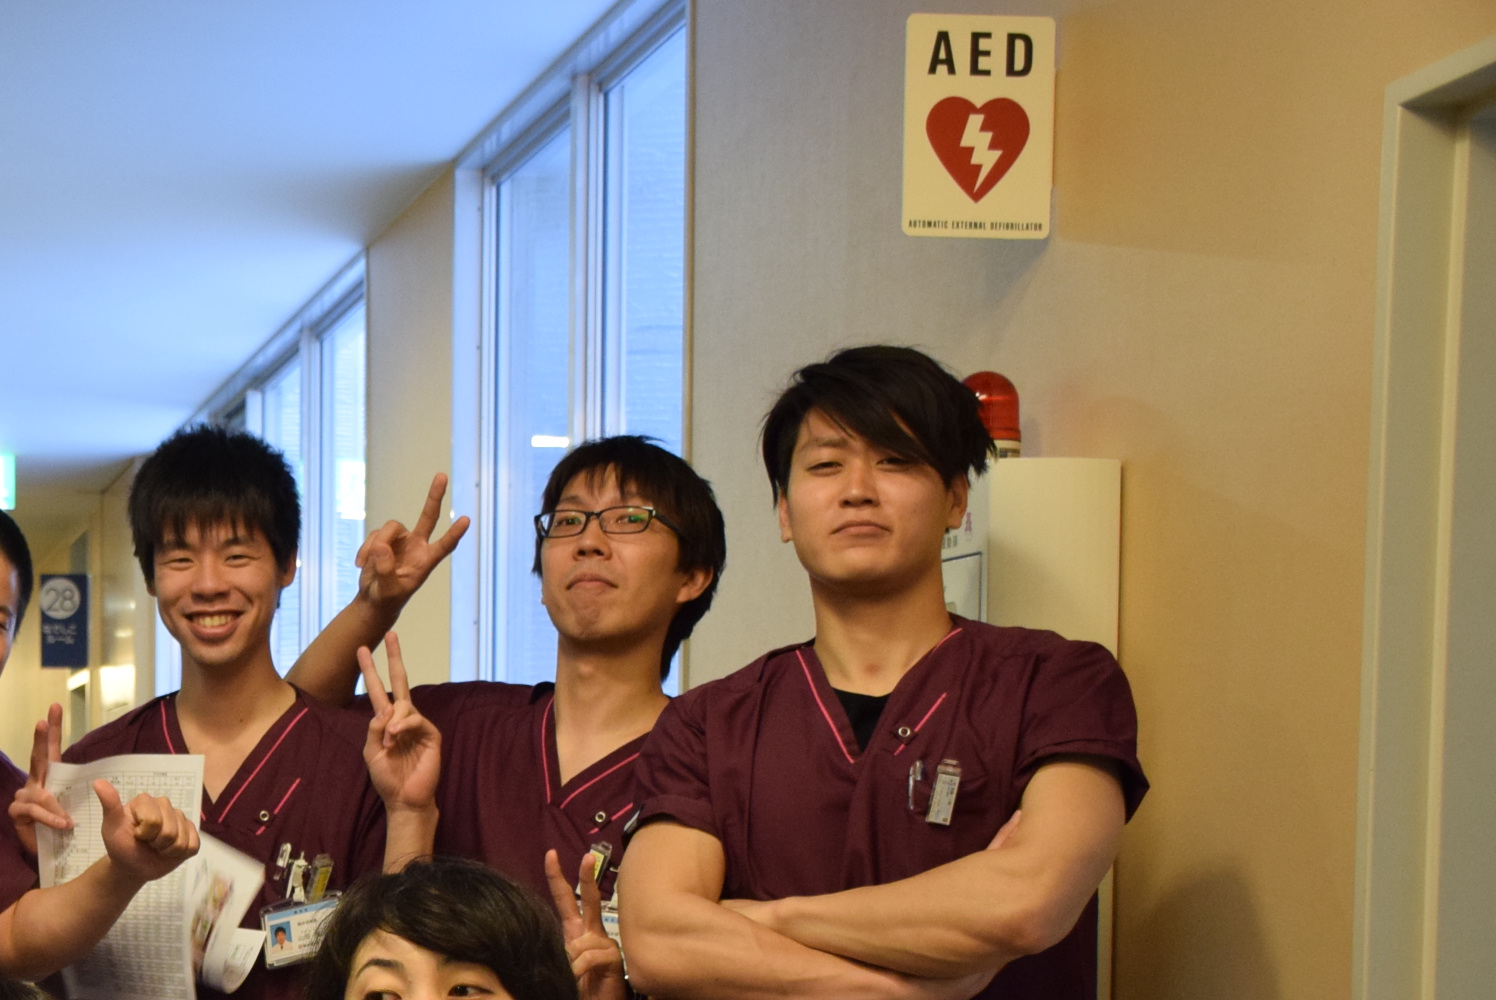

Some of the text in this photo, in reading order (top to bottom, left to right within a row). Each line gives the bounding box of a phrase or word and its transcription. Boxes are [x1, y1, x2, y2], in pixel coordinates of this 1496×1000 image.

[928, 30, 1033, 77] AED
[908, 219, 1043, 231] AUTOMATIC EXTERNAL DEFIBRILLATOR
[45, 588, 76, 612] 28
